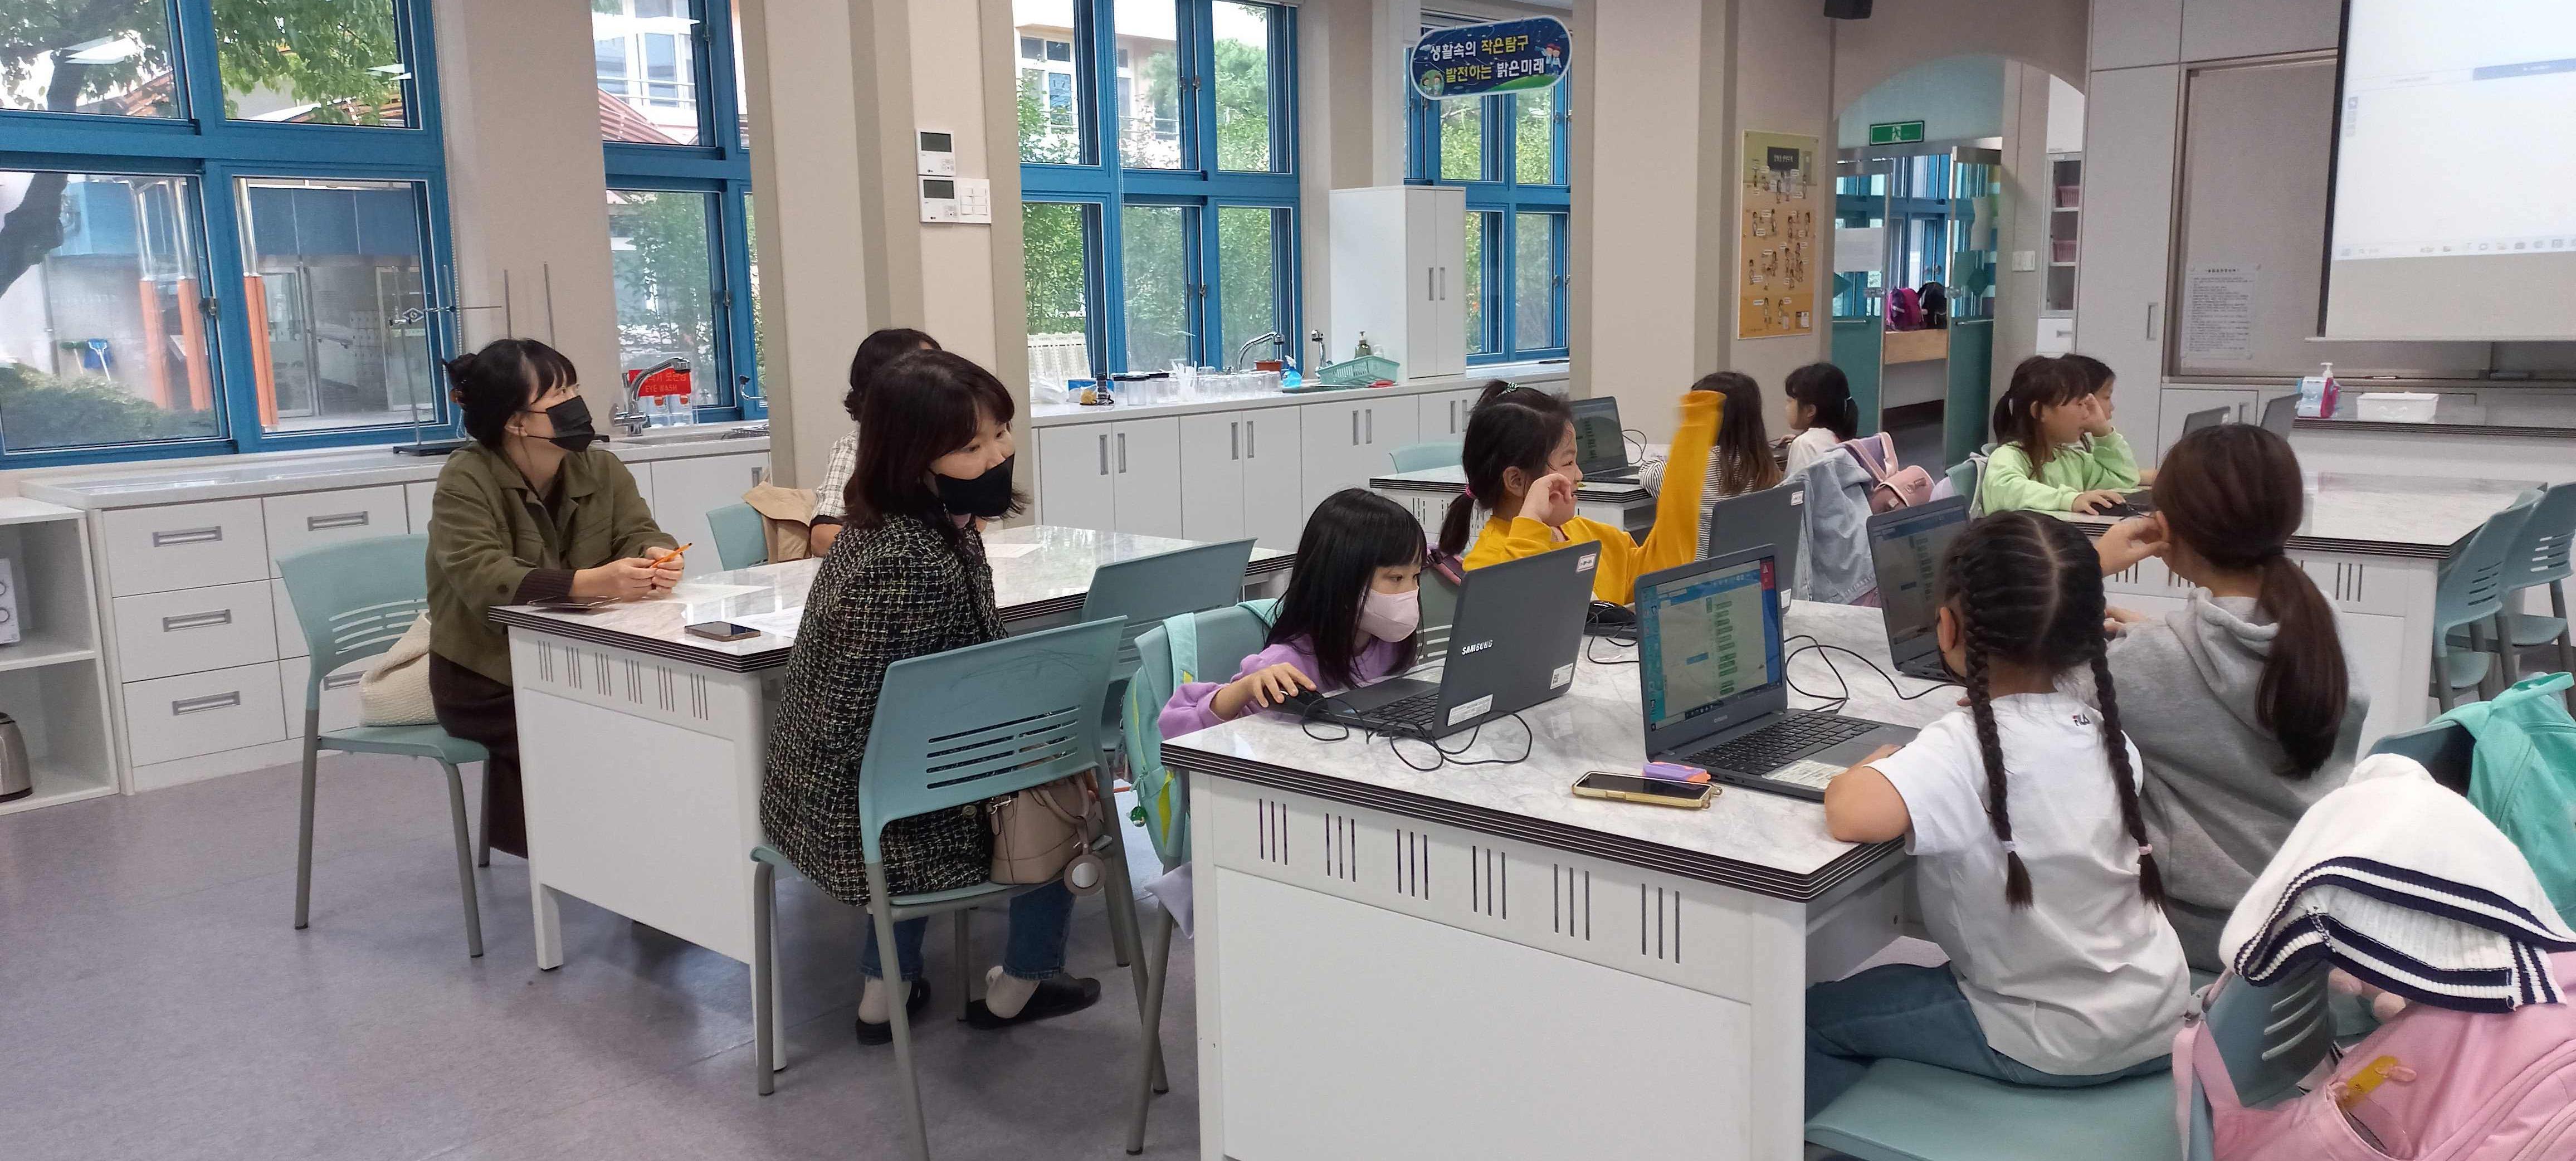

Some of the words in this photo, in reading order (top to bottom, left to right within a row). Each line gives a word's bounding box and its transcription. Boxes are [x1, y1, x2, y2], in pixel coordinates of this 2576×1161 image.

[1430, 41, 1476, 61] 생활속의
[1481, 35, 1529, 55] 작은탐구
[1446, 65, 1492, 83] 발전하는
[1497, 58, 1544, 78] 밝은미래
[1462, 640, 1493, 655] SAMSUNG
